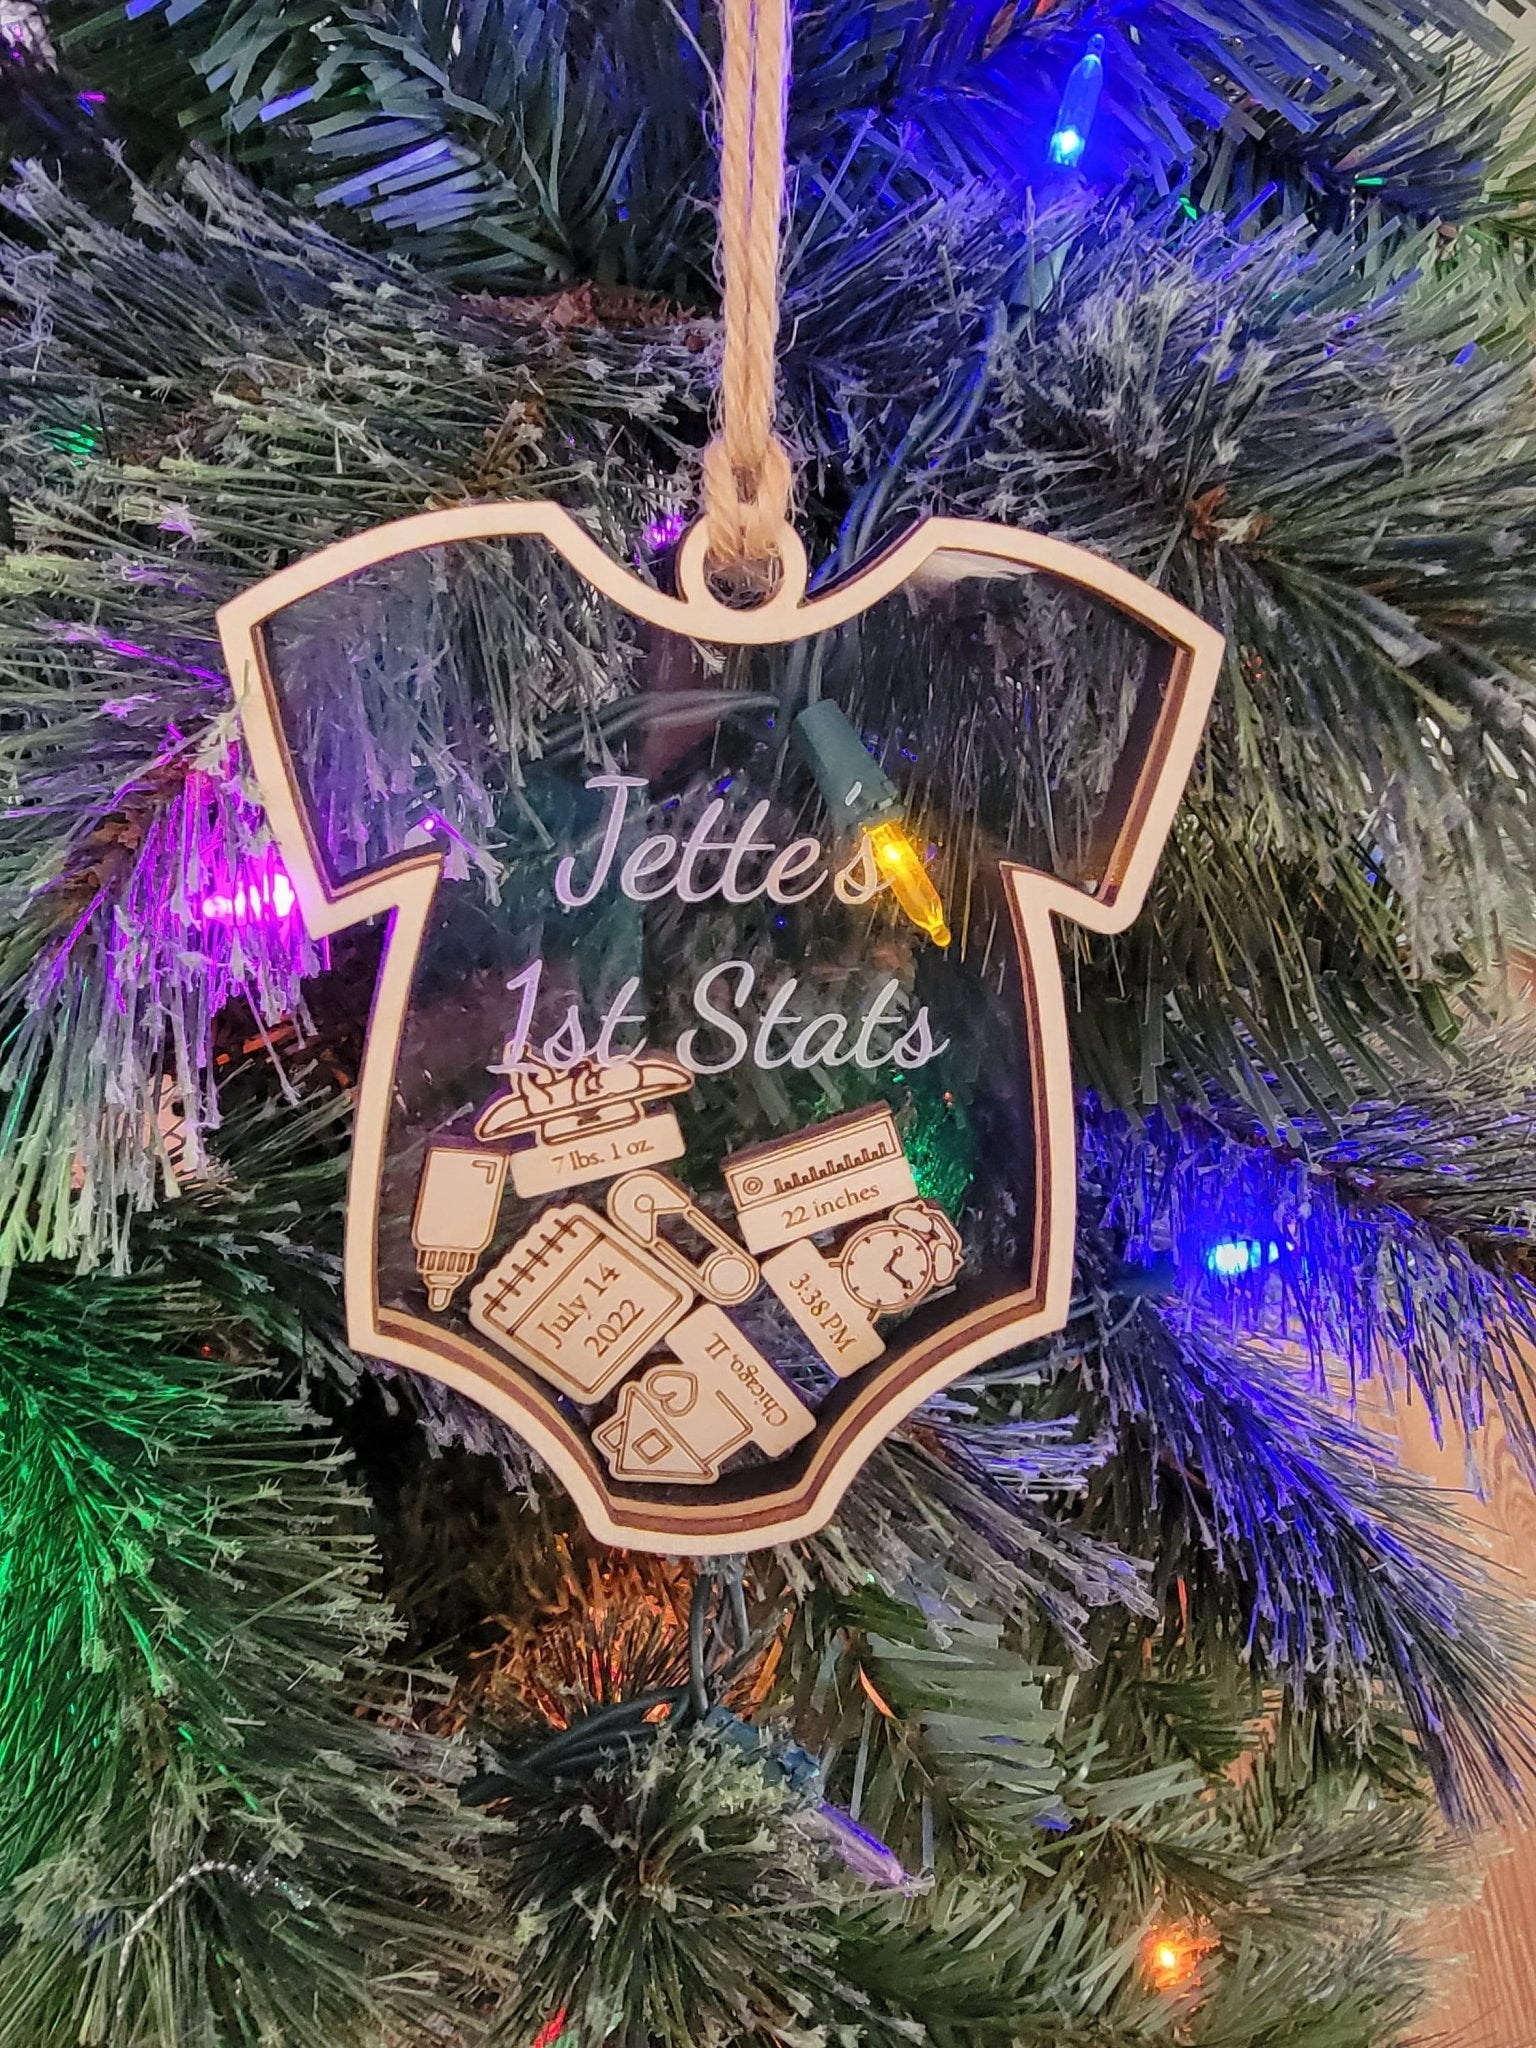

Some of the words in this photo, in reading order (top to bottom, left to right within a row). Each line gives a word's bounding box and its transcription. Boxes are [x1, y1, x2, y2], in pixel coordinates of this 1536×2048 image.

[555, 775, 896, 906] Jette's
[487, 959, 648, 1075] 1st
[676, 960, 951, 1076] Stats
[551, 1155, 565, 1175] 7
[568, 1149, 606, 1171] lbs.
[610, 1142, 623, 1161] 1
[782, 1205, 811, 1229] 22
[812, 1184, 881, 1218] inches
[537, 1293, 592, 1350] July
[583, 1262, 622, 1297] 14
[584, 1299, 645, 1359] 2022
[789, 1272, 831, 1317] 3:38
[819, 1311, 858, 1354] PM
[730, 1353, 789, 1427] Chicago,
